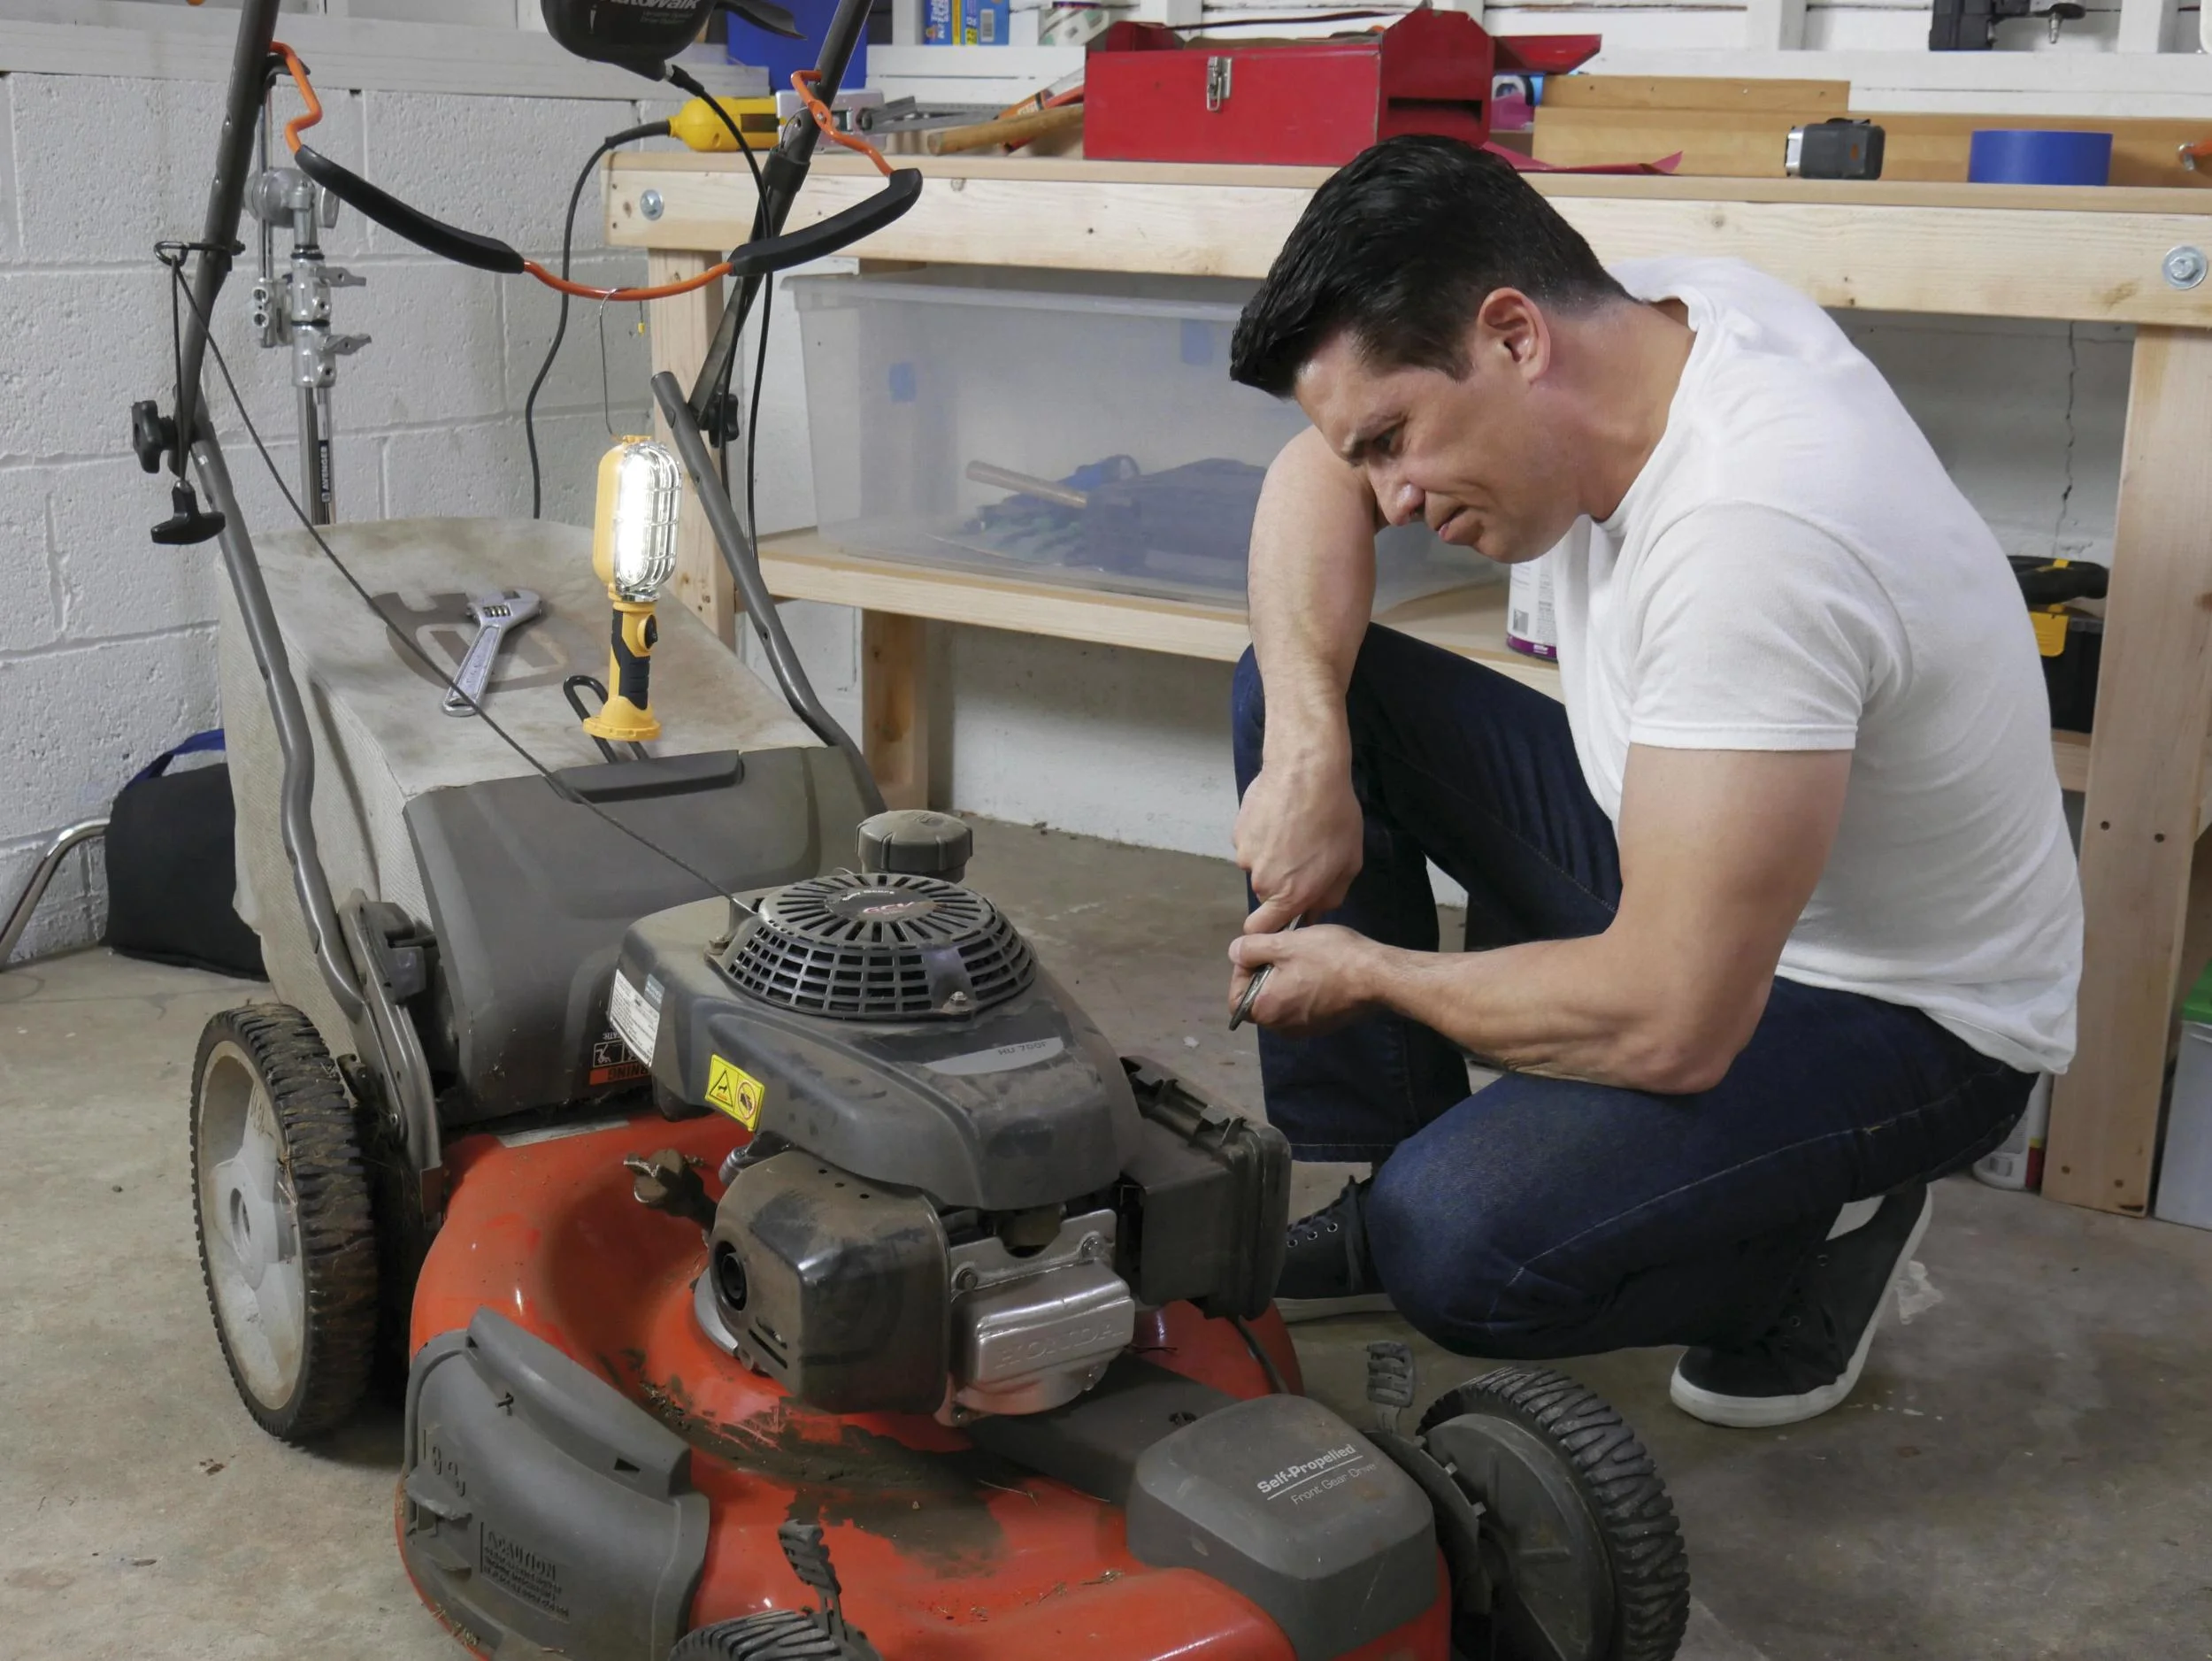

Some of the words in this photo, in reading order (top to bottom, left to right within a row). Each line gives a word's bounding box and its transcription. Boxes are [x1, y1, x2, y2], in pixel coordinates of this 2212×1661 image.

[320, 445, 329, 489] AVENGER
[1256, 1443, 1356, 1493] Self-Propelled
[1290, 1485, 1323, 1504] Front
[1321, 1473, 1347, 1490] Gear
